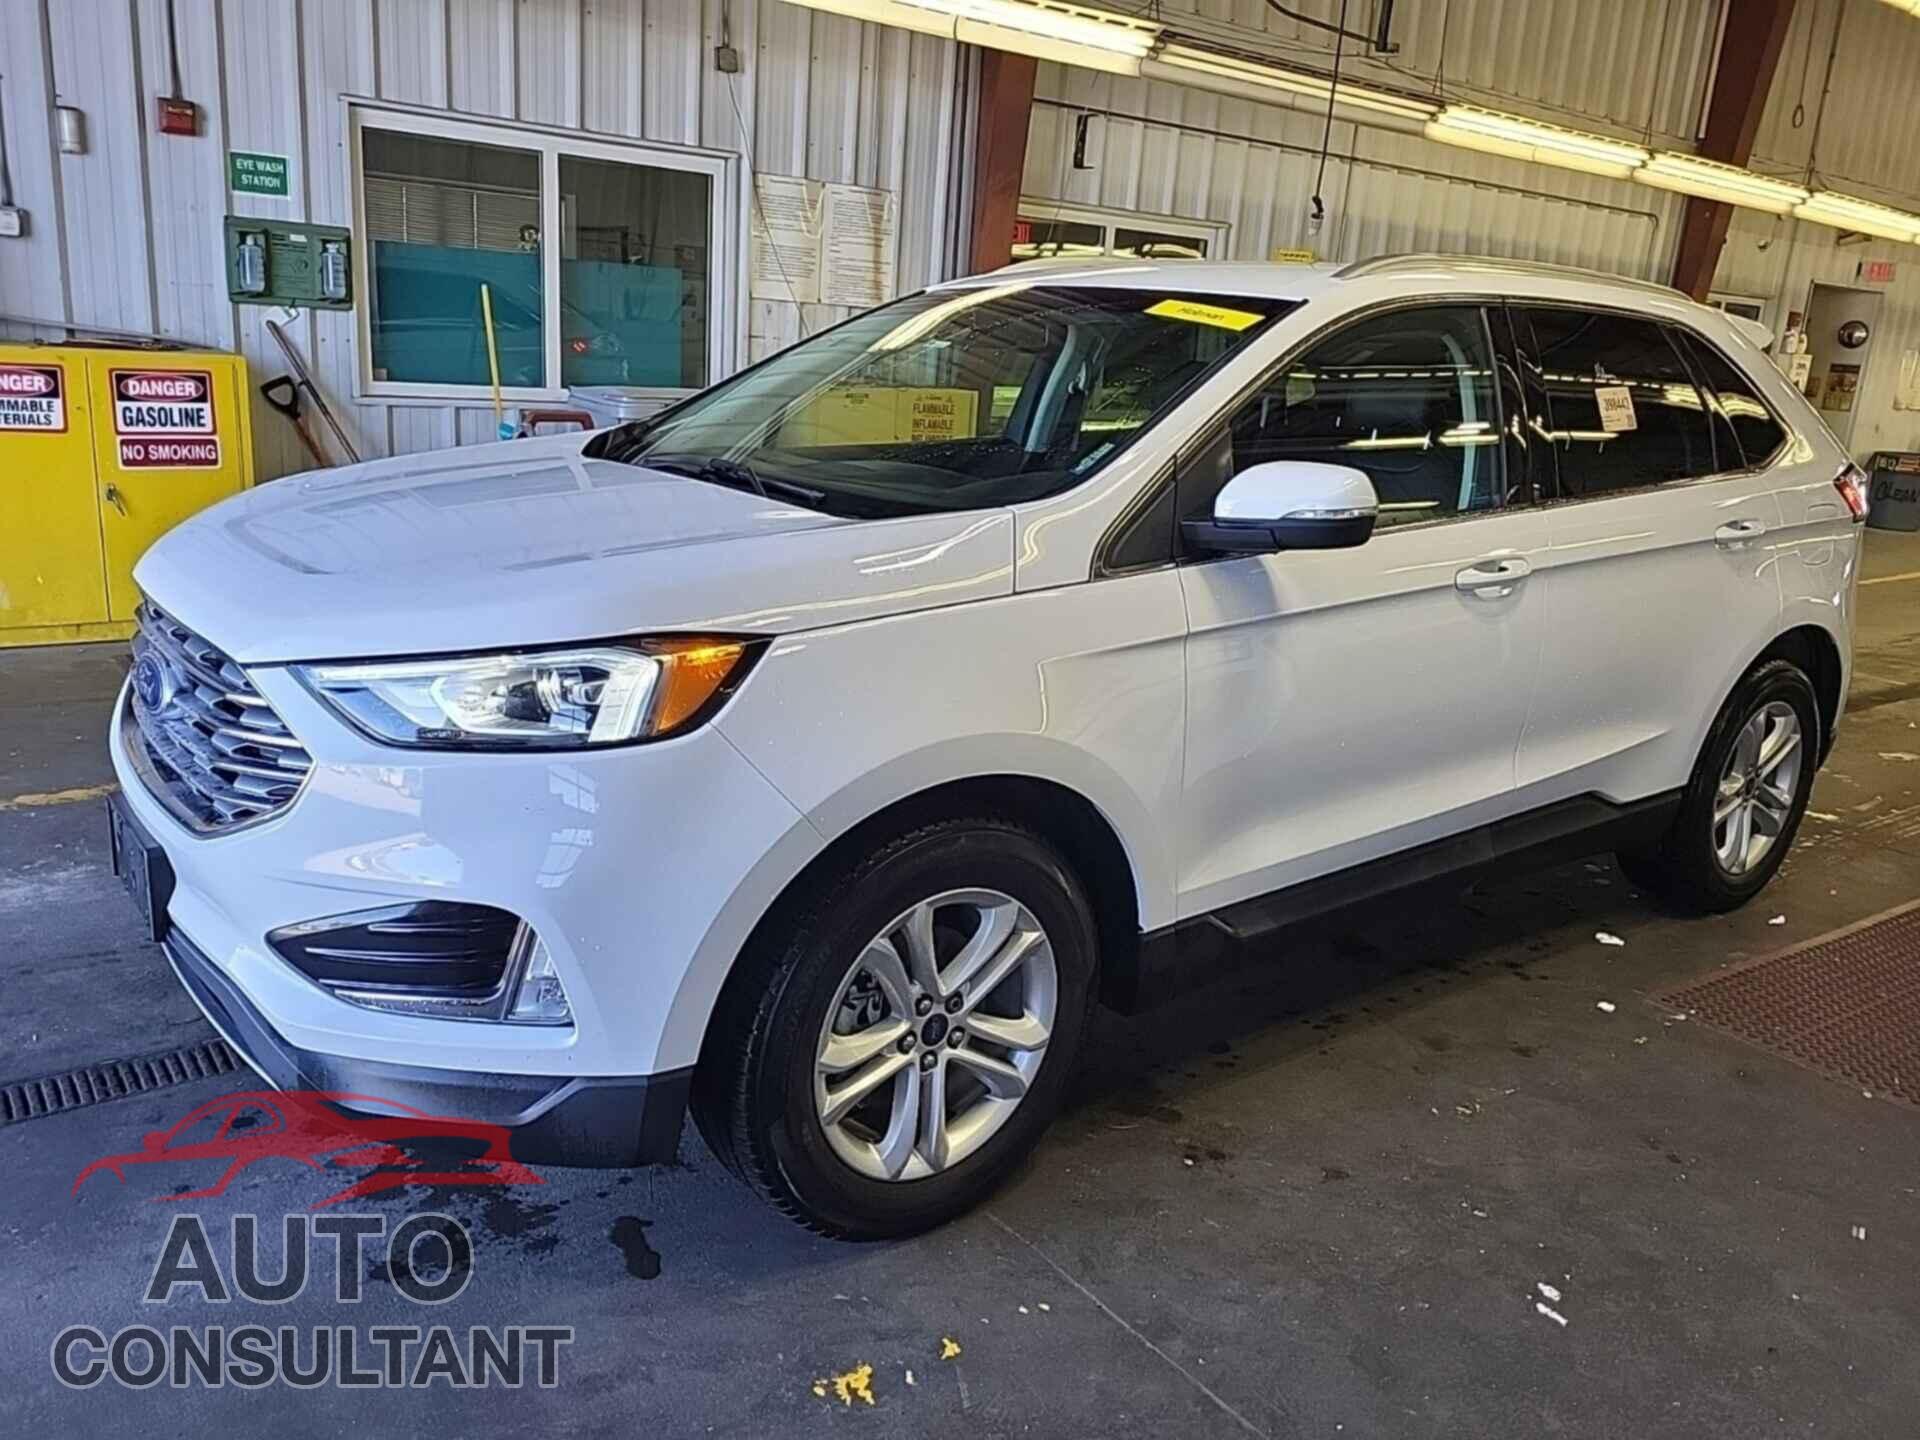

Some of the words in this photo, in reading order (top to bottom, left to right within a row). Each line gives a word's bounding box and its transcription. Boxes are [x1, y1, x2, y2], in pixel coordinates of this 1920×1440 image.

[236, 158, 254, 170] EYE
[255, 160, 284, 174] WASH
[241, 174, 281, 188] STATION
[127, 379, 197, 397] DANGER
[122, 406, 206, 428] GASOLINE
[122, 444, 145, 460] NO
[148, 444, 217, 461] SMOKING
